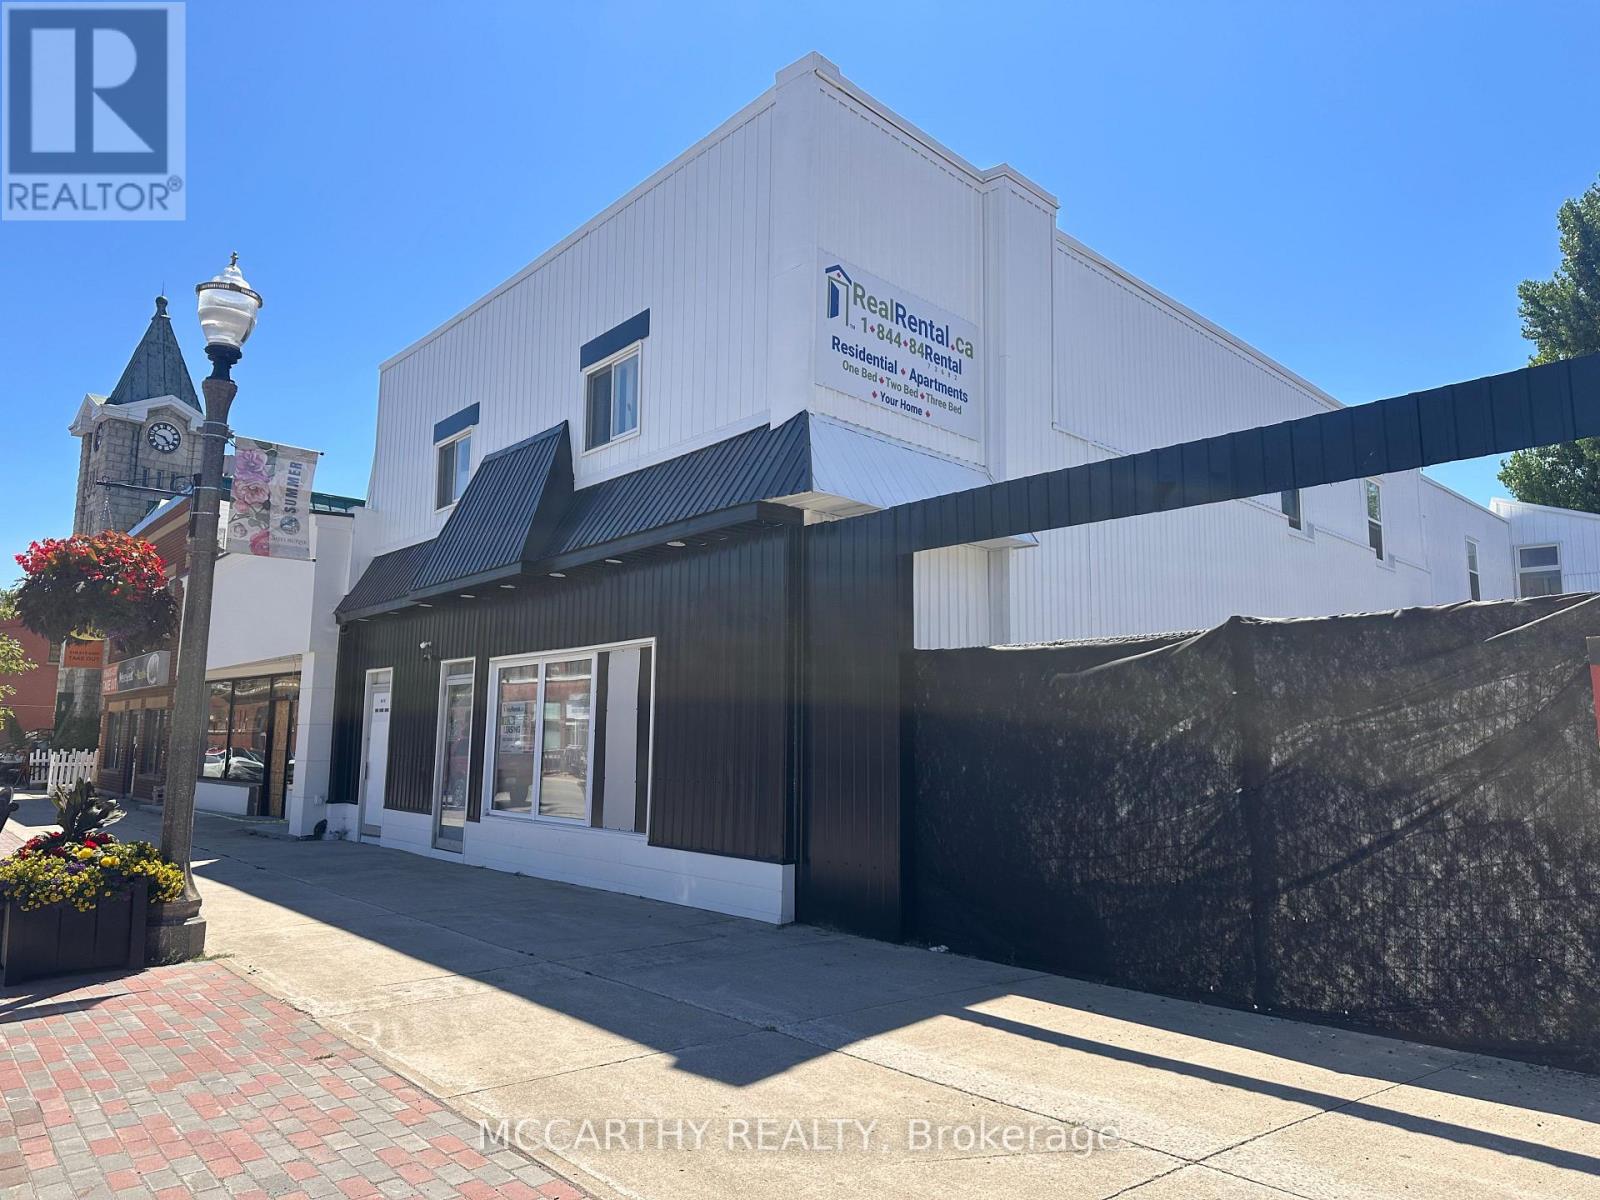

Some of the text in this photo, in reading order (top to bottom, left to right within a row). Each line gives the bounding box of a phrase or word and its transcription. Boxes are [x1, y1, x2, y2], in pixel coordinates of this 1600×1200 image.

[853, 282, 974, 359] RealRental.ca
[832, 335, 968, 403] Residential Apartments
[842, 360, 962, 415] One Bed Two Bed Three Bed
[880, 391, 923, 416] Your Home
[284, 461, 303, 513] SUMMER
